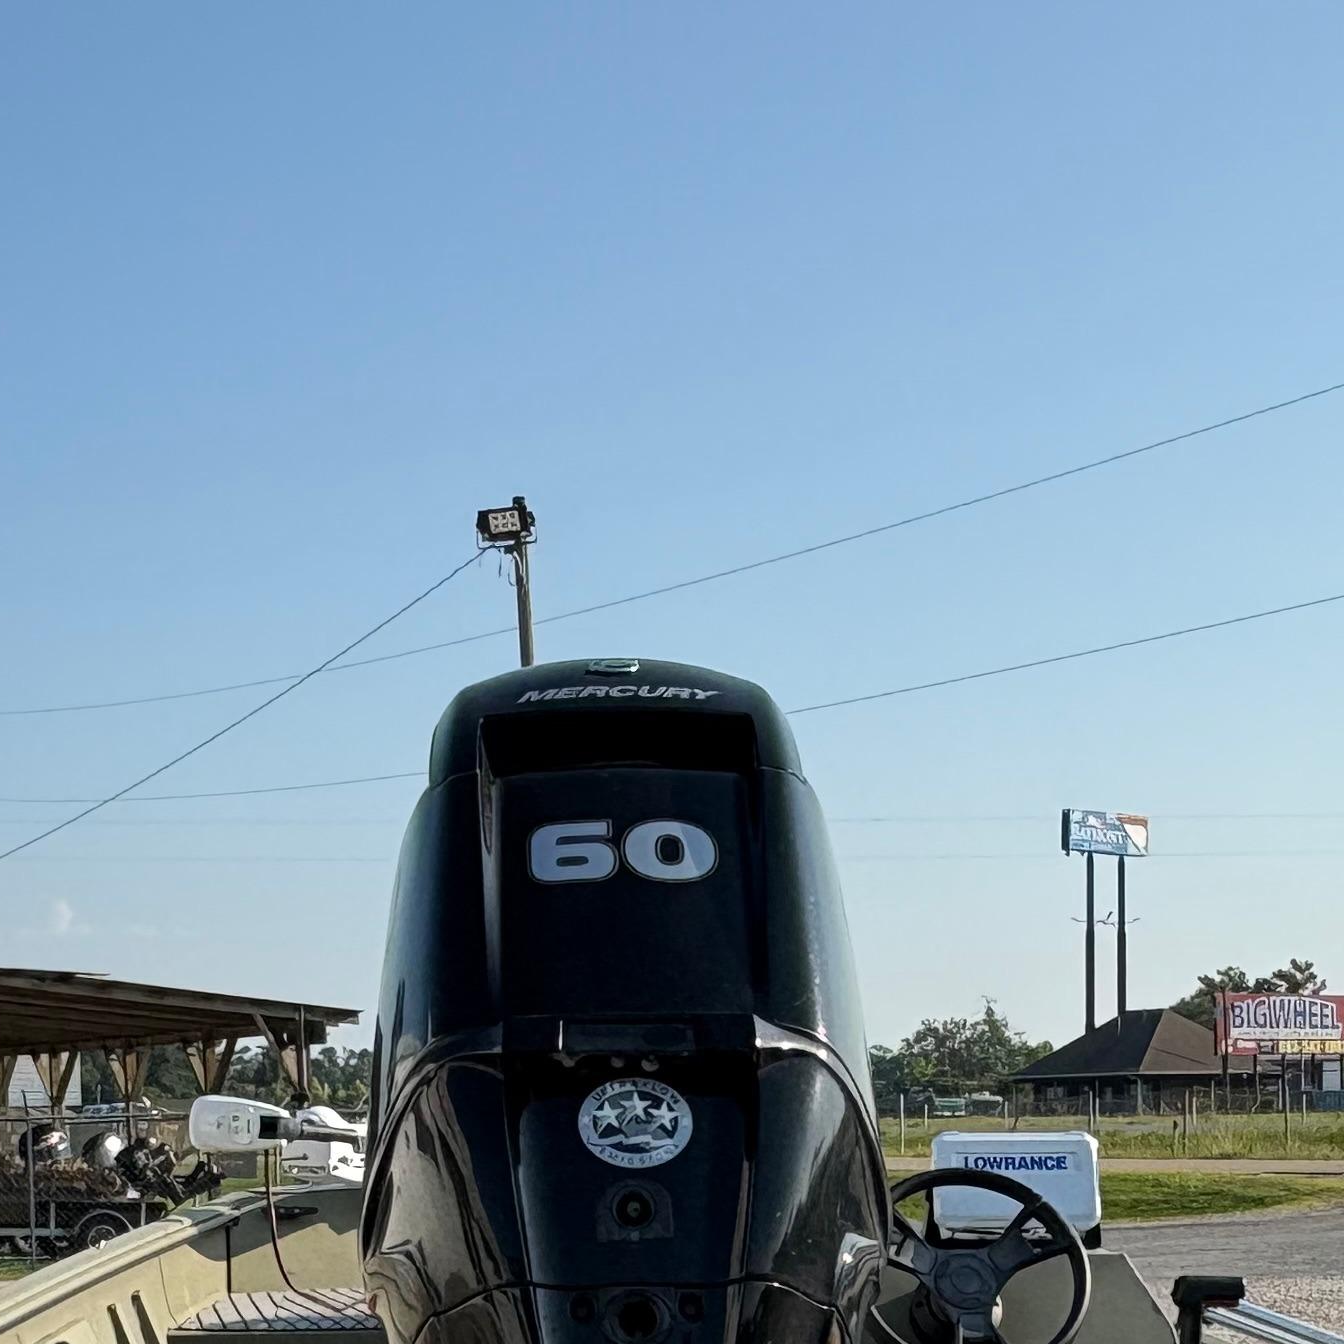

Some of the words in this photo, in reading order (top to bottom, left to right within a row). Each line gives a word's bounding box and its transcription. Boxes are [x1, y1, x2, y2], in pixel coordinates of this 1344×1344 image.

[517, 685, 722, 704] MERCURY
[527, 819, 718, 883] 60
[964, 1156, 1068, 1171] LOWRANCE
